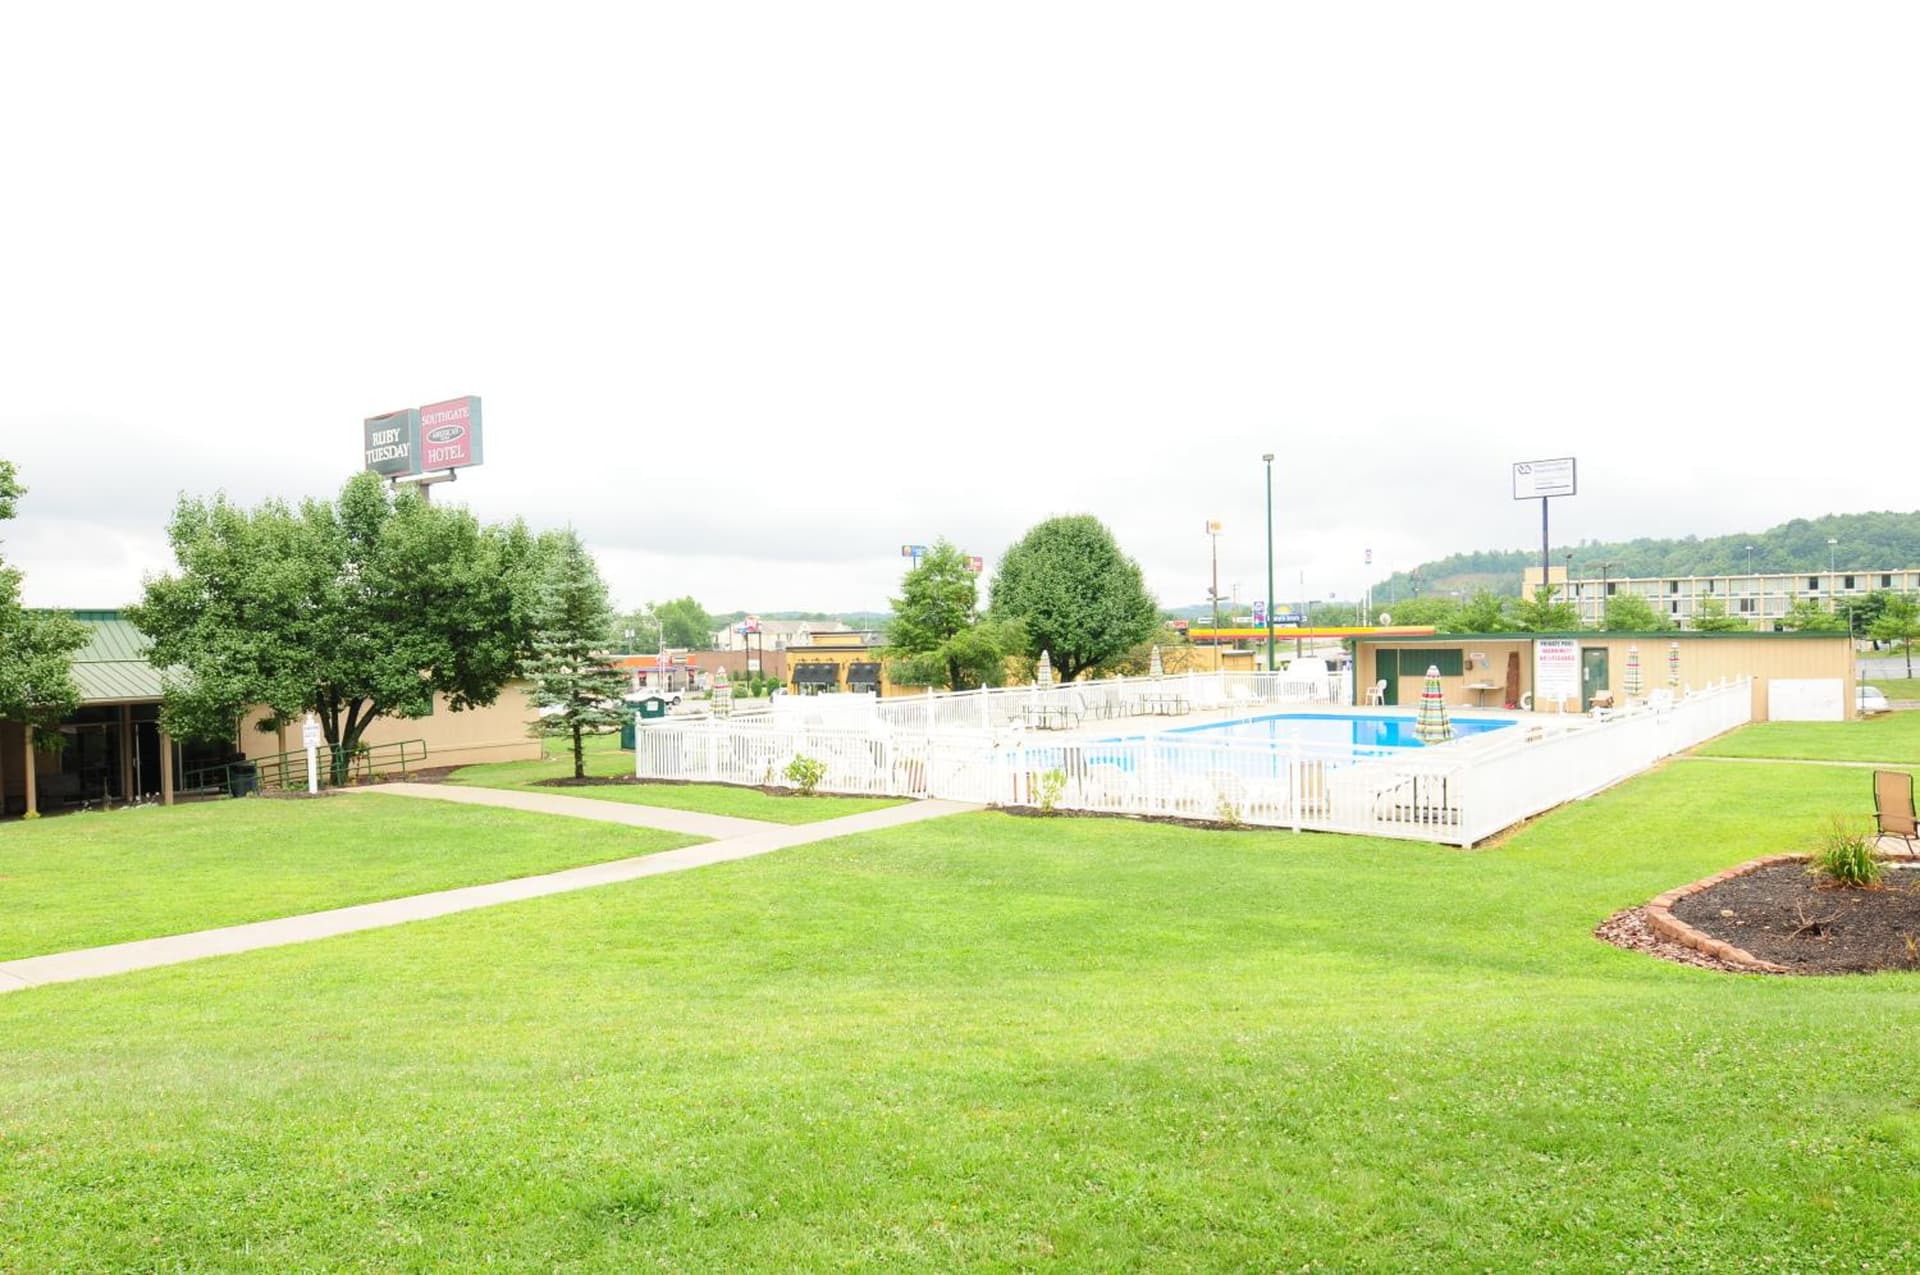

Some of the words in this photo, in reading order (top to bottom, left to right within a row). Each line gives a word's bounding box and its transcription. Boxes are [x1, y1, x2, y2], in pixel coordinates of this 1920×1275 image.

[422, 407, 470, 426] SOUTHGATE
[372, 428, 400, 447] RUBY
[366, 442, 410, 464] TUESDAY
[428, 445, 465, 464] HOTEL
